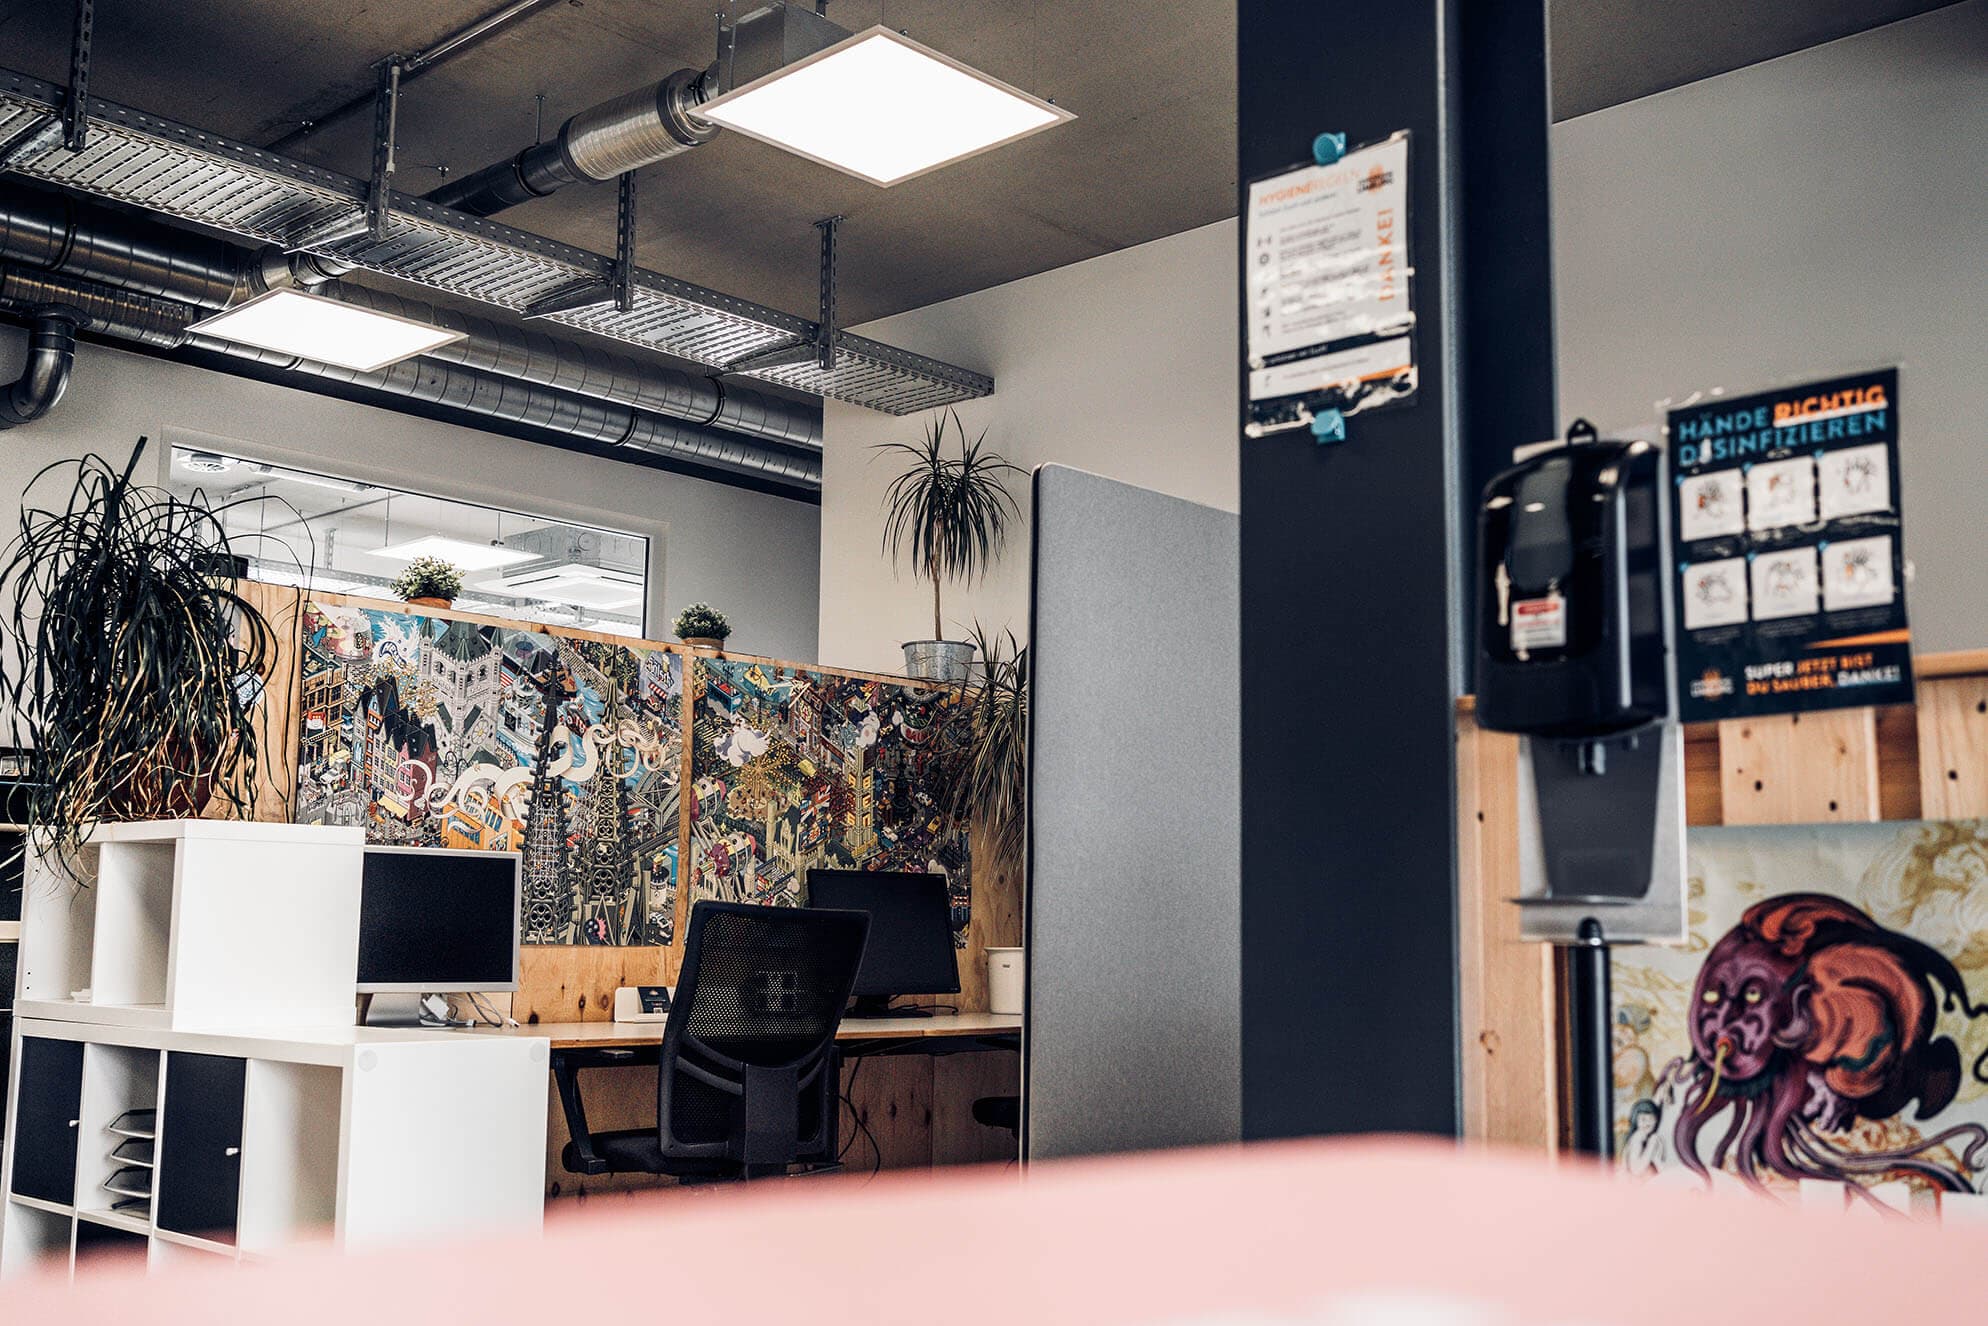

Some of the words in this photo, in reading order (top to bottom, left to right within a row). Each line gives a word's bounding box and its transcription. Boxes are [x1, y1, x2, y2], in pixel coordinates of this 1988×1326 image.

[1678, 406, 1770, 443] HÄNDE
[1773, 384, 1887, 422] RICHTIG
[1745, 679, 1770, 696] DU
